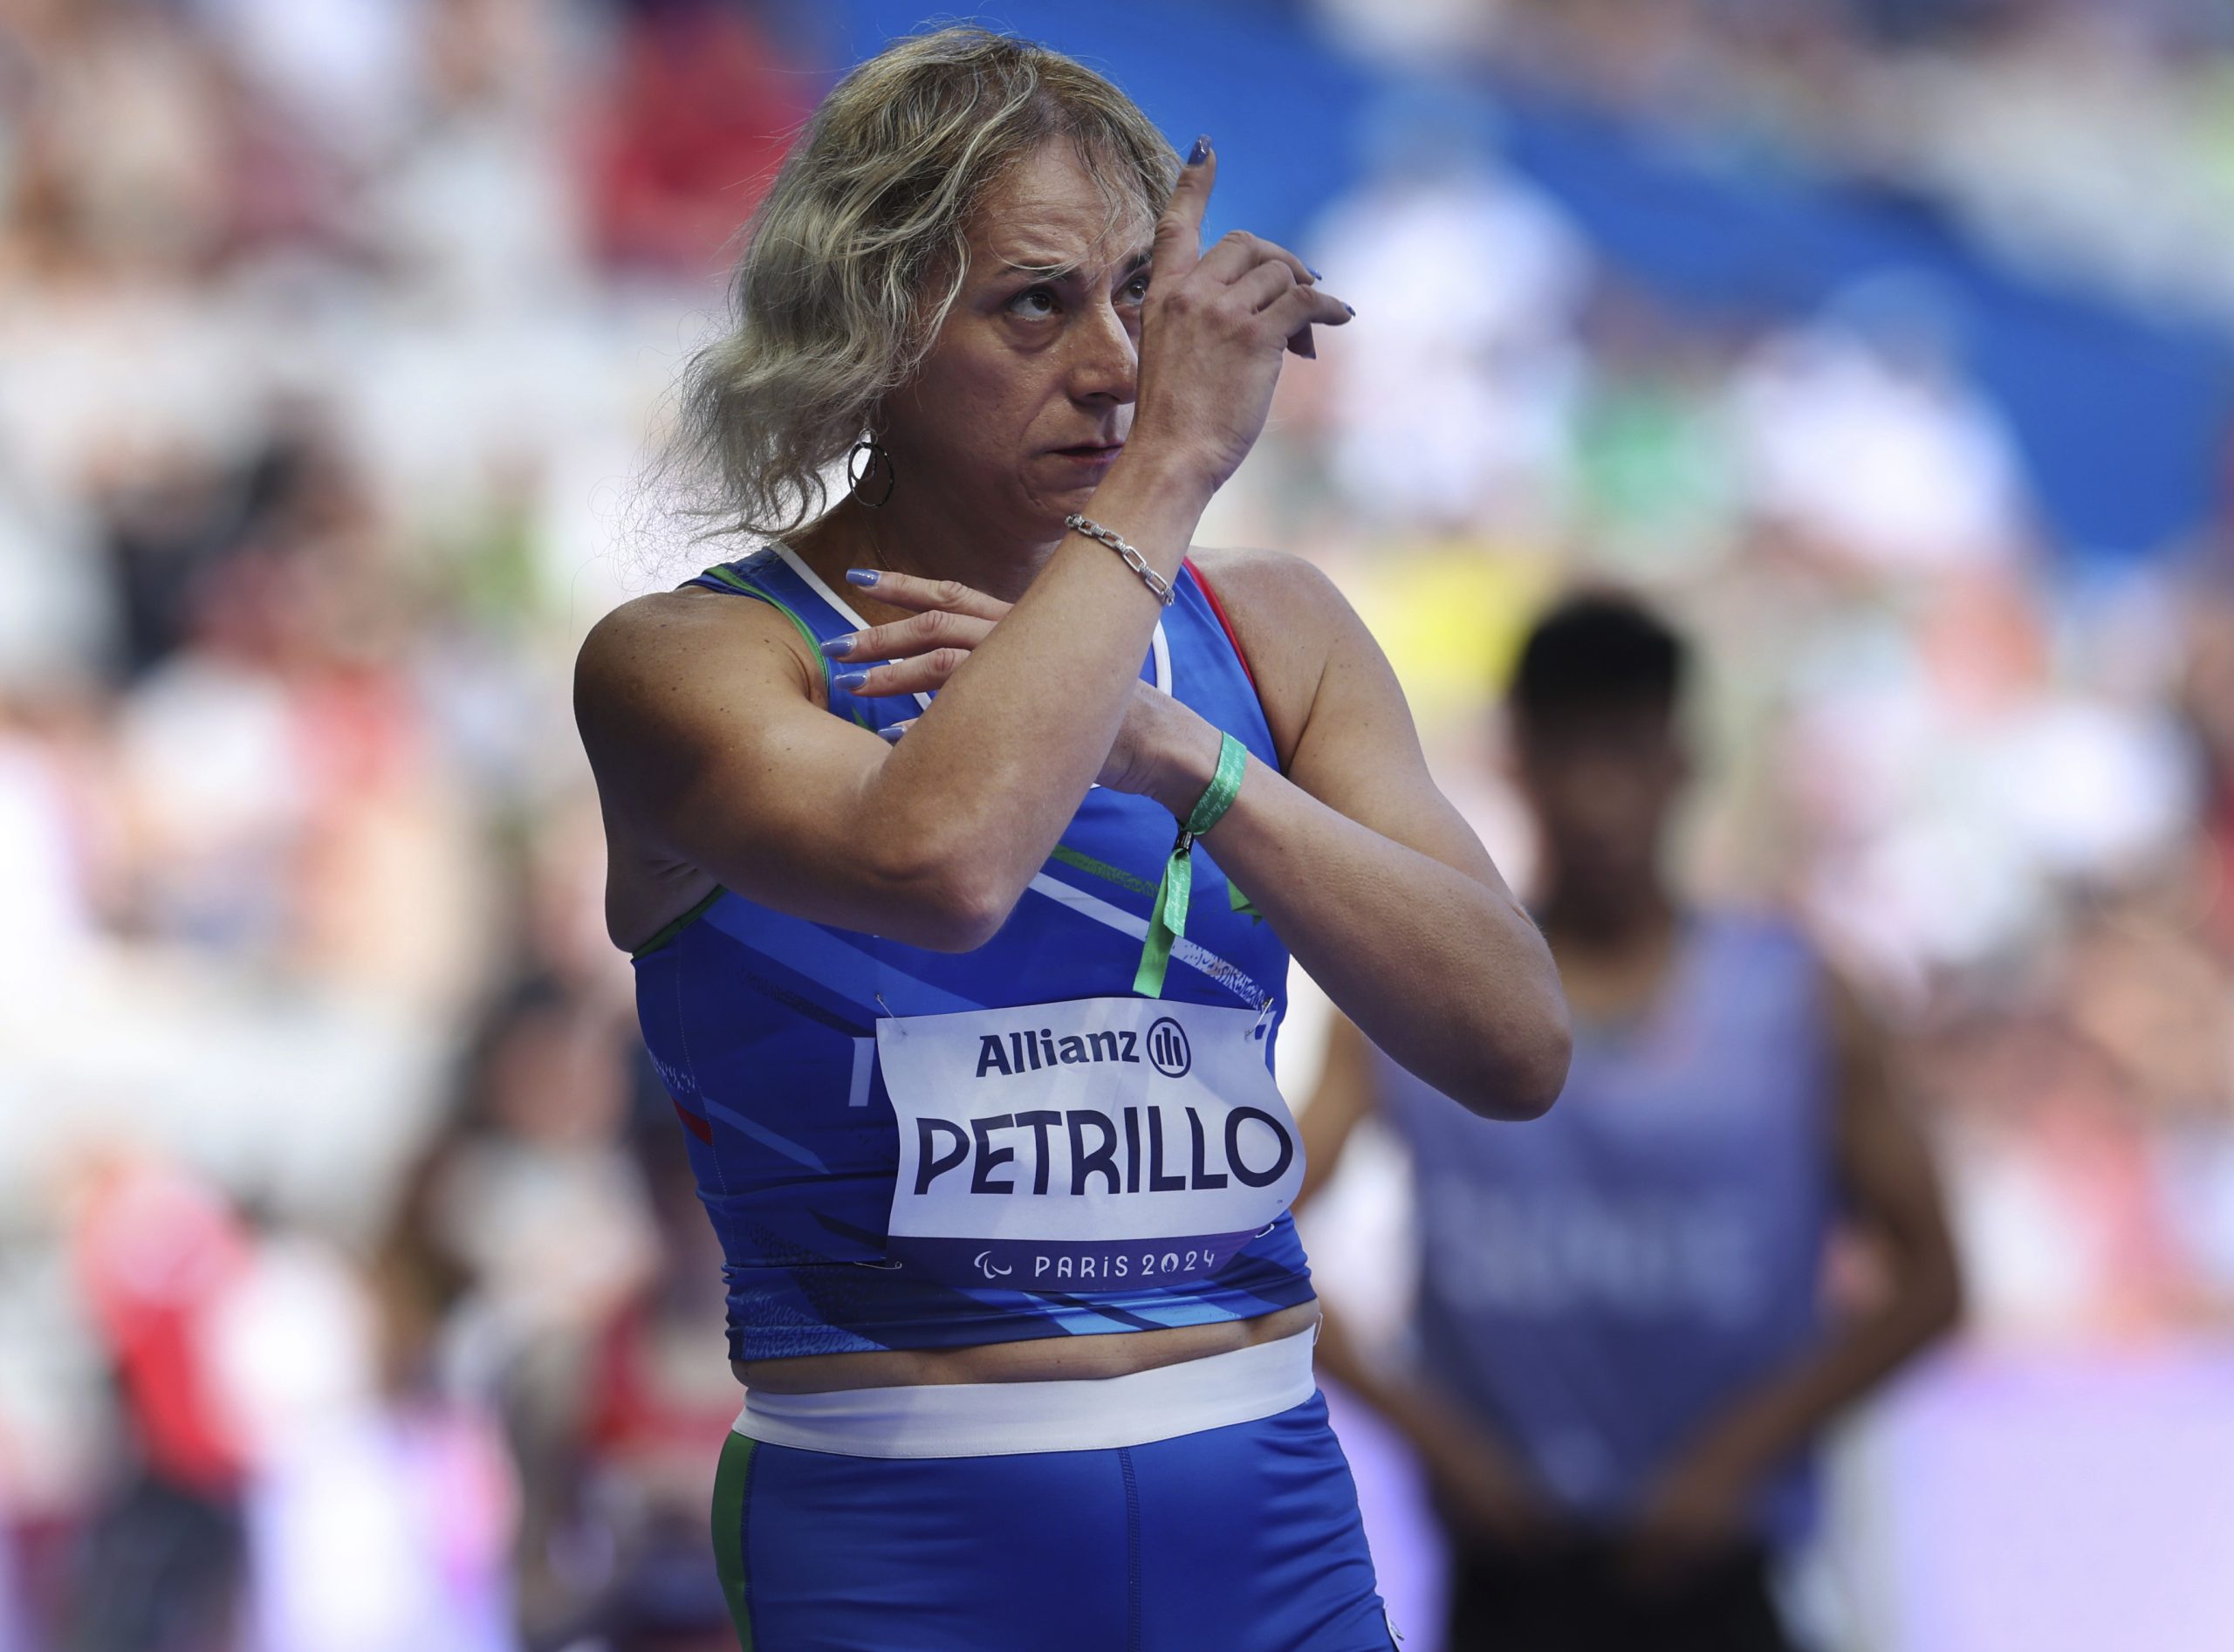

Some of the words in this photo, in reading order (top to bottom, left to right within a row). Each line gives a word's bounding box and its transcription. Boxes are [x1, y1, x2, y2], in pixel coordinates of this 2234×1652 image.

[976, 1028, 1141, 1078] Allianz
[913, 1105, 1294, 1196] PETRILLO
[1141, 1249, 1216, 1276] 2024
